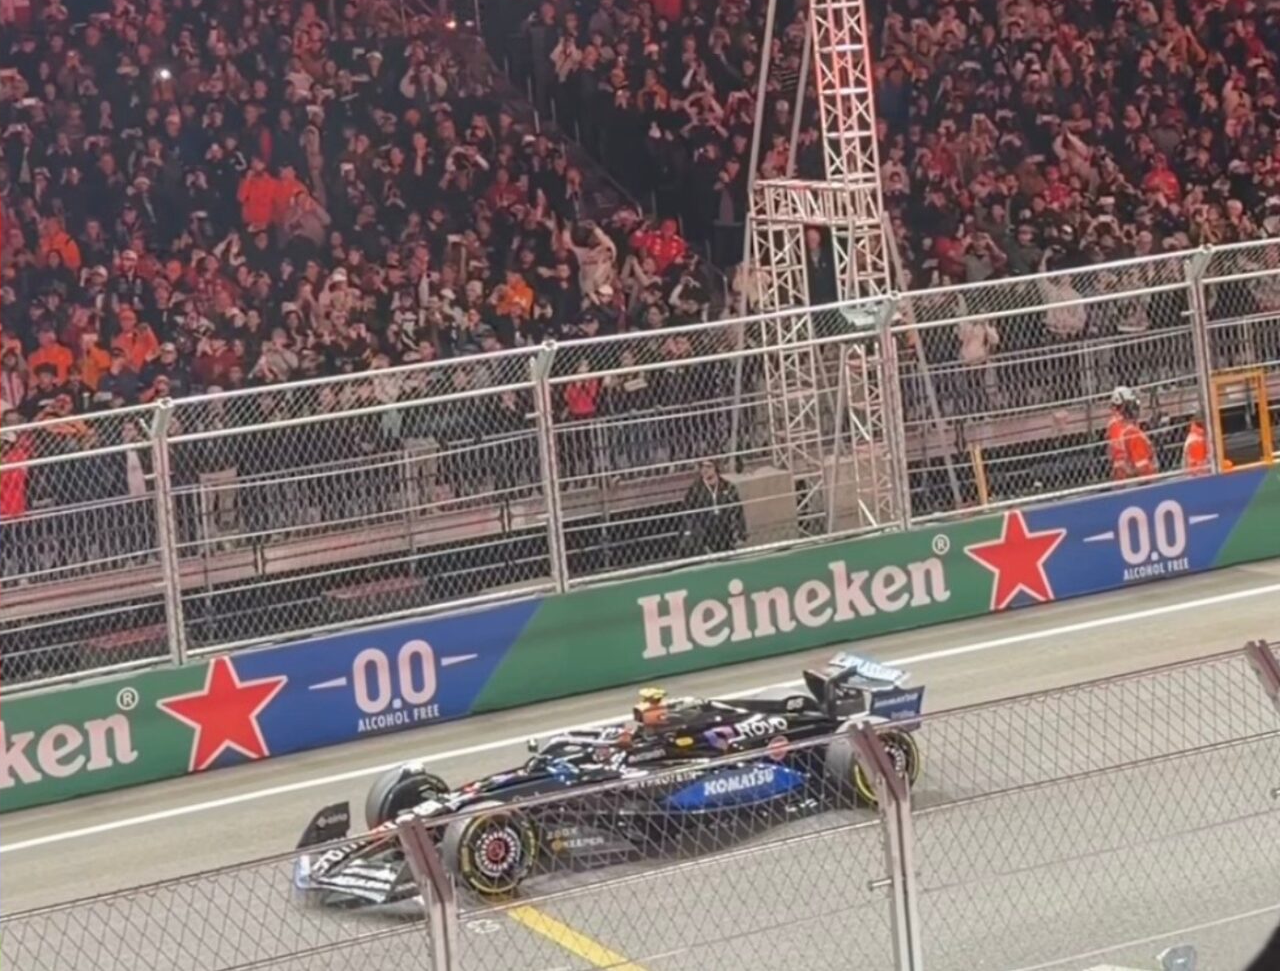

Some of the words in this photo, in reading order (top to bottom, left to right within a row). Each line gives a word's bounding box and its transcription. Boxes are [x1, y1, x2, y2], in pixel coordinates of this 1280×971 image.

[1123, 564, 1165, 581] ALCOHOL
[1169, 557, 1190, 573] FREE
[358, 710, 410, 732] ALCOHOL
[413, 704, 440, 721] FREE
[703, 767, 775, 796] KOMATSU
